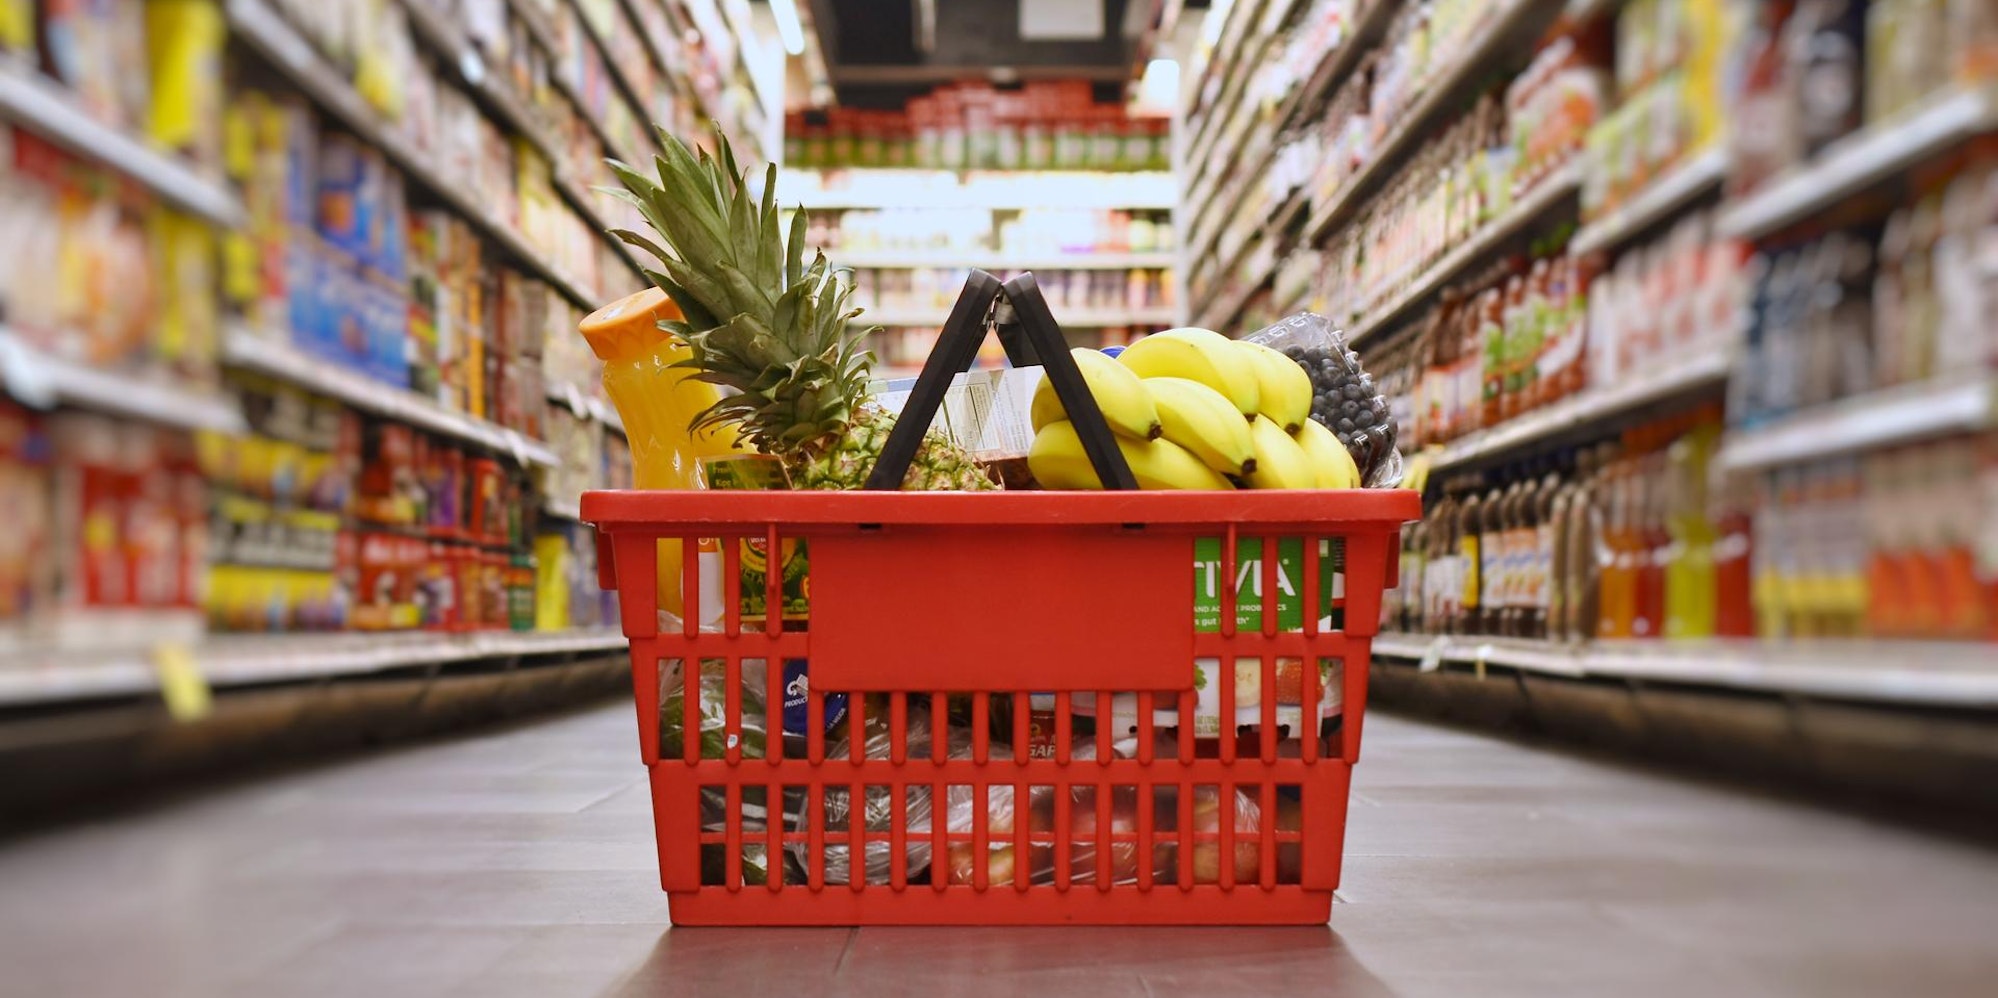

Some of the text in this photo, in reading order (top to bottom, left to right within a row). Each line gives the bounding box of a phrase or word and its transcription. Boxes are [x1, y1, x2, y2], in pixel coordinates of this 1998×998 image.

[1194, 560, 1296, 598] IVIA
[1241, 603, 1287, 611] PROBCS
[1202, 618, 1217, 626] gut
